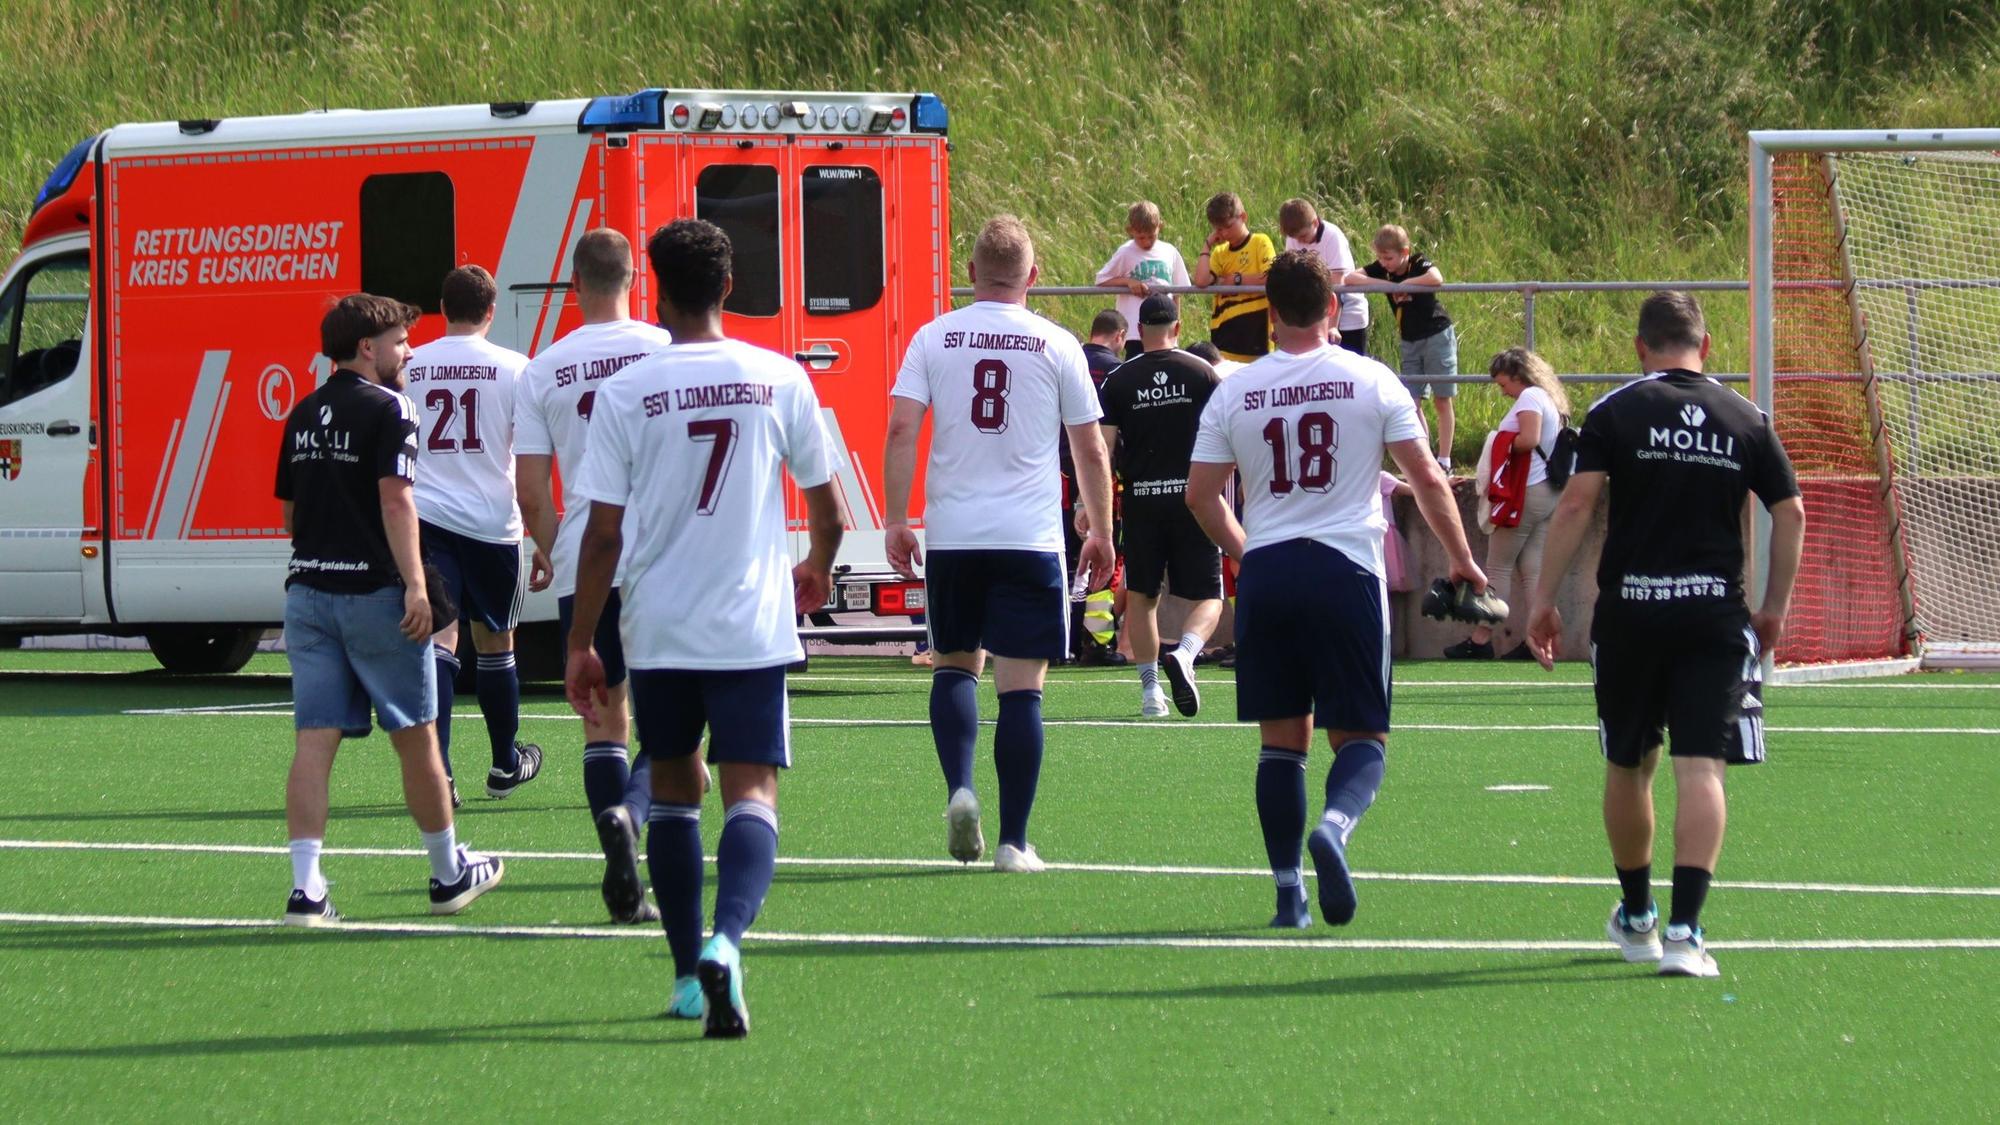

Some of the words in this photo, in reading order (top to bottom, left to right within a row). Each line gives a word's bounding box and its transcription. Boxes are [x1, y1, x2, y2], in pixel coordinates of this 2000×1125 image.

[818, 168, 862, 180] WLW/RTW-1
[134, 221, 343, 256] RETTUNGSDIENST
[128, 257, 190, 287] KREIS
[198, 252, 339, 284] EUSKIRCHEN
[944, 332, 966, 349] SSV
[969, 332, 1046, 354] LOMMERSUM
[410, 366, 426, 383] SSV
[430, 365, 497, 381] LOMMERSUM
[555, 364, 577, 388] SSV
[643, 390, 669, 418] SSV
[675, 383, 773, 411] LOMMERSUM
[971, 359, 1012, 434] 8
[1137, 384, 1185, 402] MOLLI
[1244, 390, 1266, 411] SSV
[1271, 381, 1354, 407] LOMMERSUM
[425, 388, 484, 454] 21
[1263, 412, 1339, 499] 18
[1637, 449, 1668, 460] Garten
[1650, 427, 1733, 456] MOLLI
[687, 418, 739, 516] 7
[1133, 488, 1150, 496] 0157
[1151, 487, 1161, 495] 39
[1162, 486, 1172, 494] 44
[1173, 485, 1183, 493] 57
[1622, 587, 1652, 601] 0157
[1655, 588, 1671, 601] 39
[1674, 587, 1690, 598] 44
[1693, 585, 1709, 596] 57
